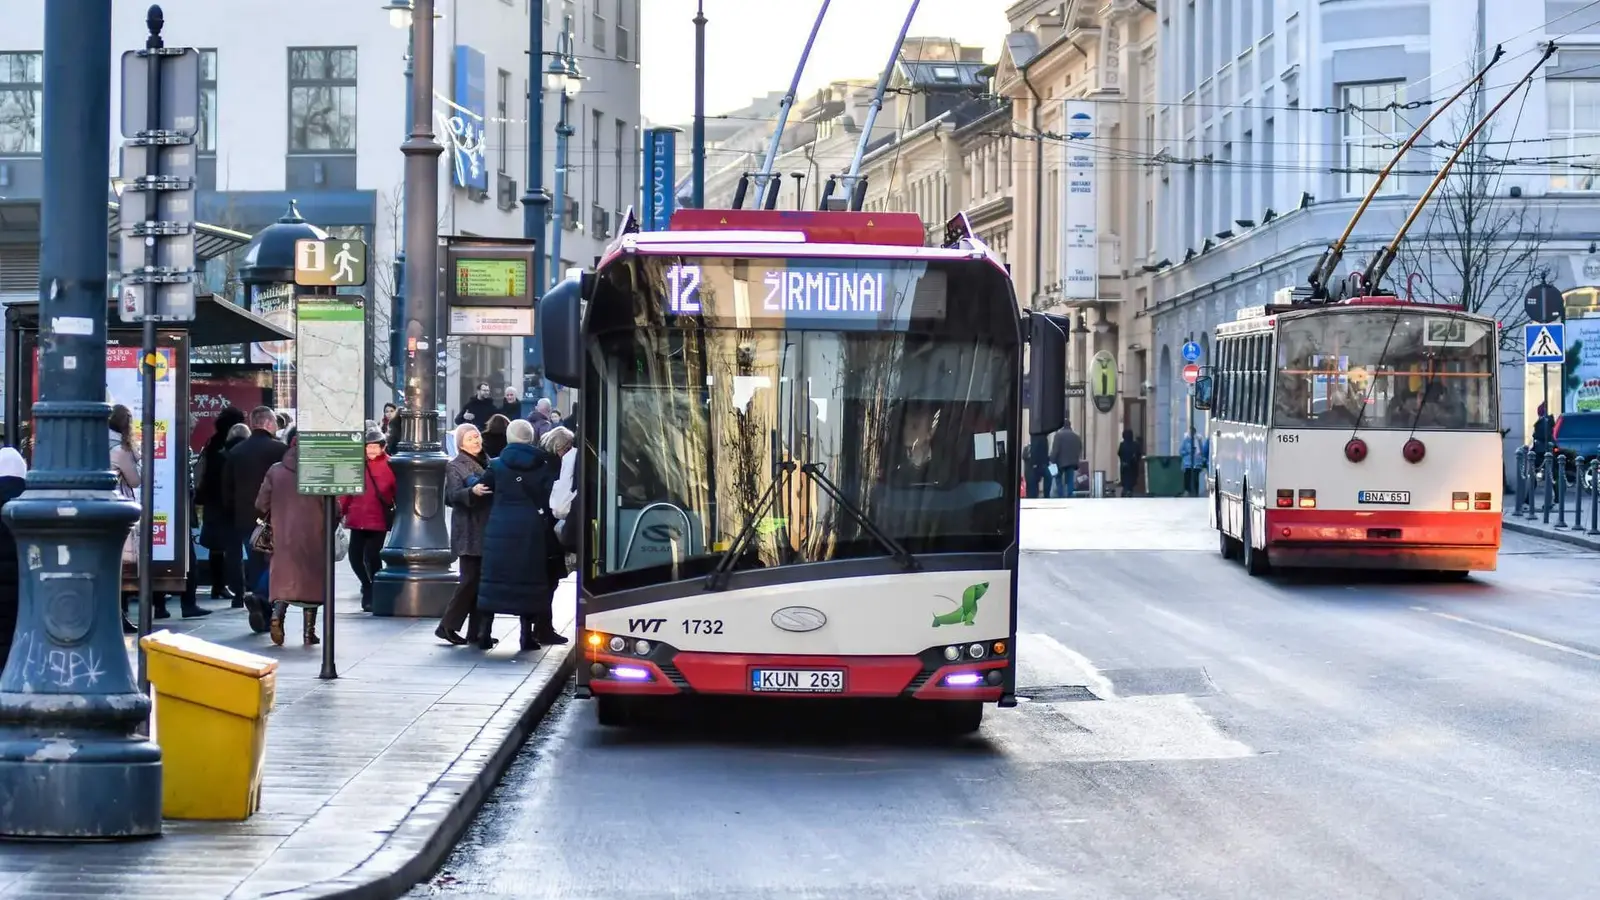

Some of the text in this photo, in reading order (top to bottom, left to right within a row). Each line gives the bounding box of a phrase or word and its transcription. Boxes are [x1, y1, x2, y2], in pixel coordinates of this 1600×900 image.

[654, 133, 665, 220] NOVOTEL
[666, 264, 883, 312] 12 ŽIRMŪNAI
[1277, 434, 1299, 443] 1651
[1364, 492, 1407, 501] BNA 651
[681, 619, 723, 635] 1732
[763, 672, 840, 688] KUN 263
